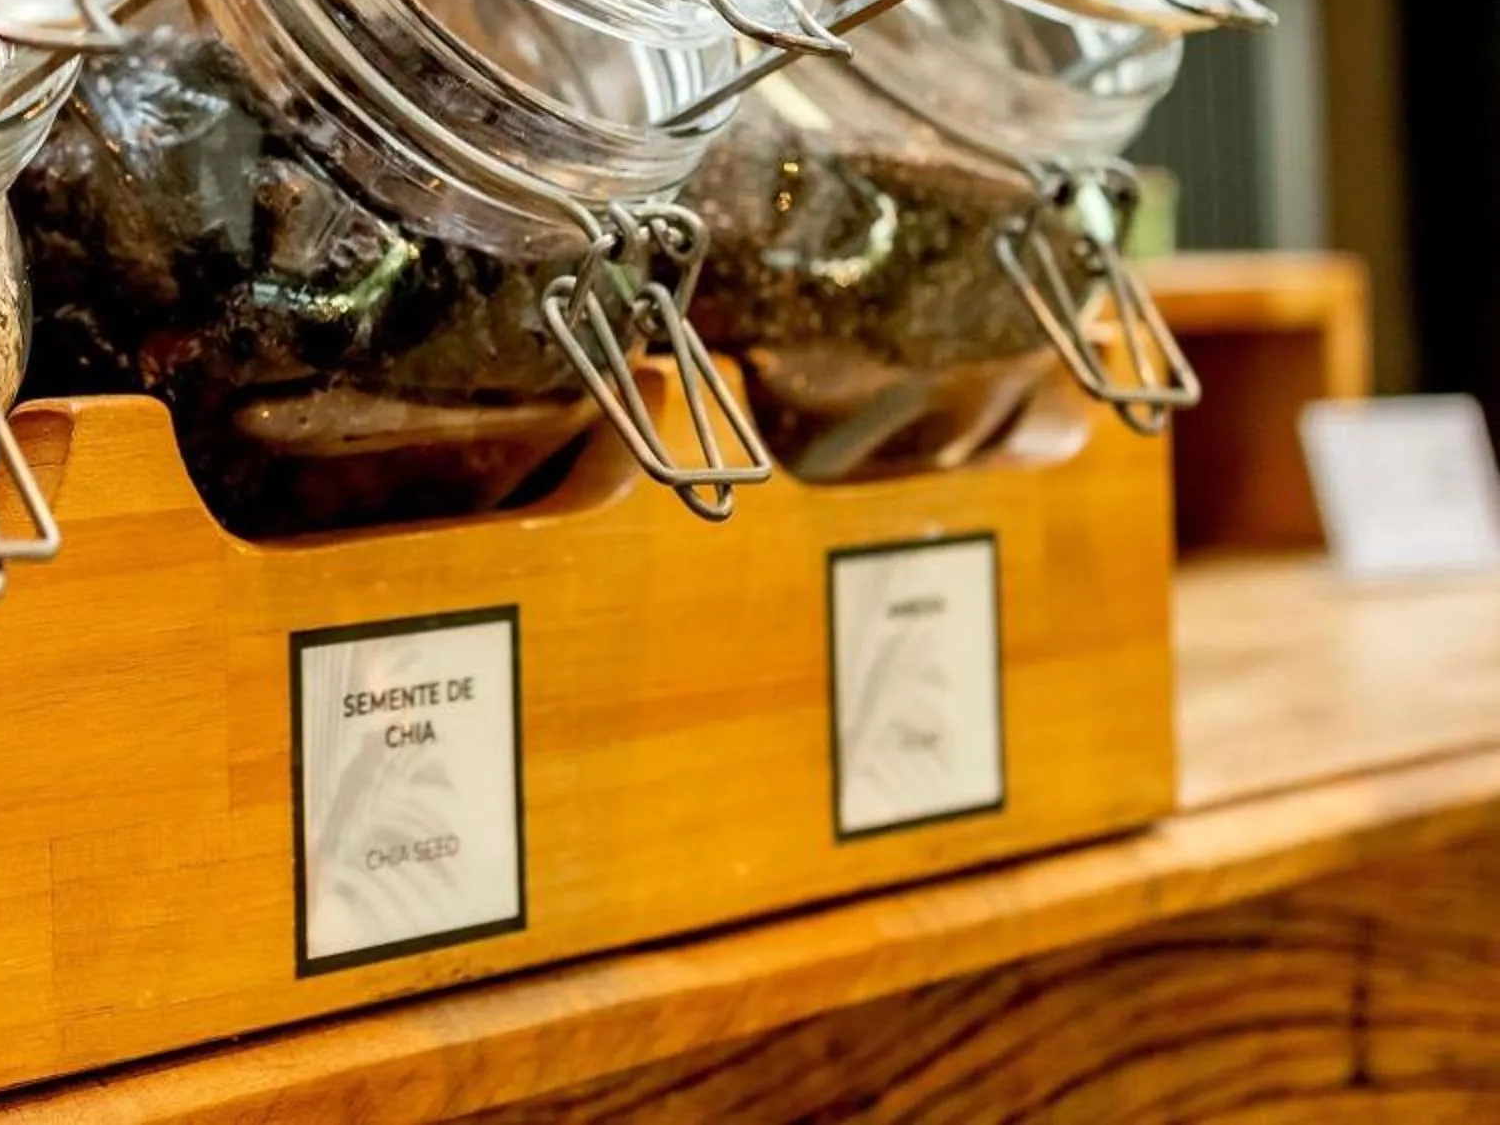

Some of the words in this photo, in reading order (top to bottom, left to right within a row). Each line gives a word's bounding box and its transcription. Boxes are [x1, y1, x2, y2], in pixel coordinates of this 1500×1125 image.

[343, 682, 440, 718] SEMENTE
[447, 676, 475, 702] DE
[385, 721, 436, 748] CHIA
[367, 843, 410, 871] CHIA
